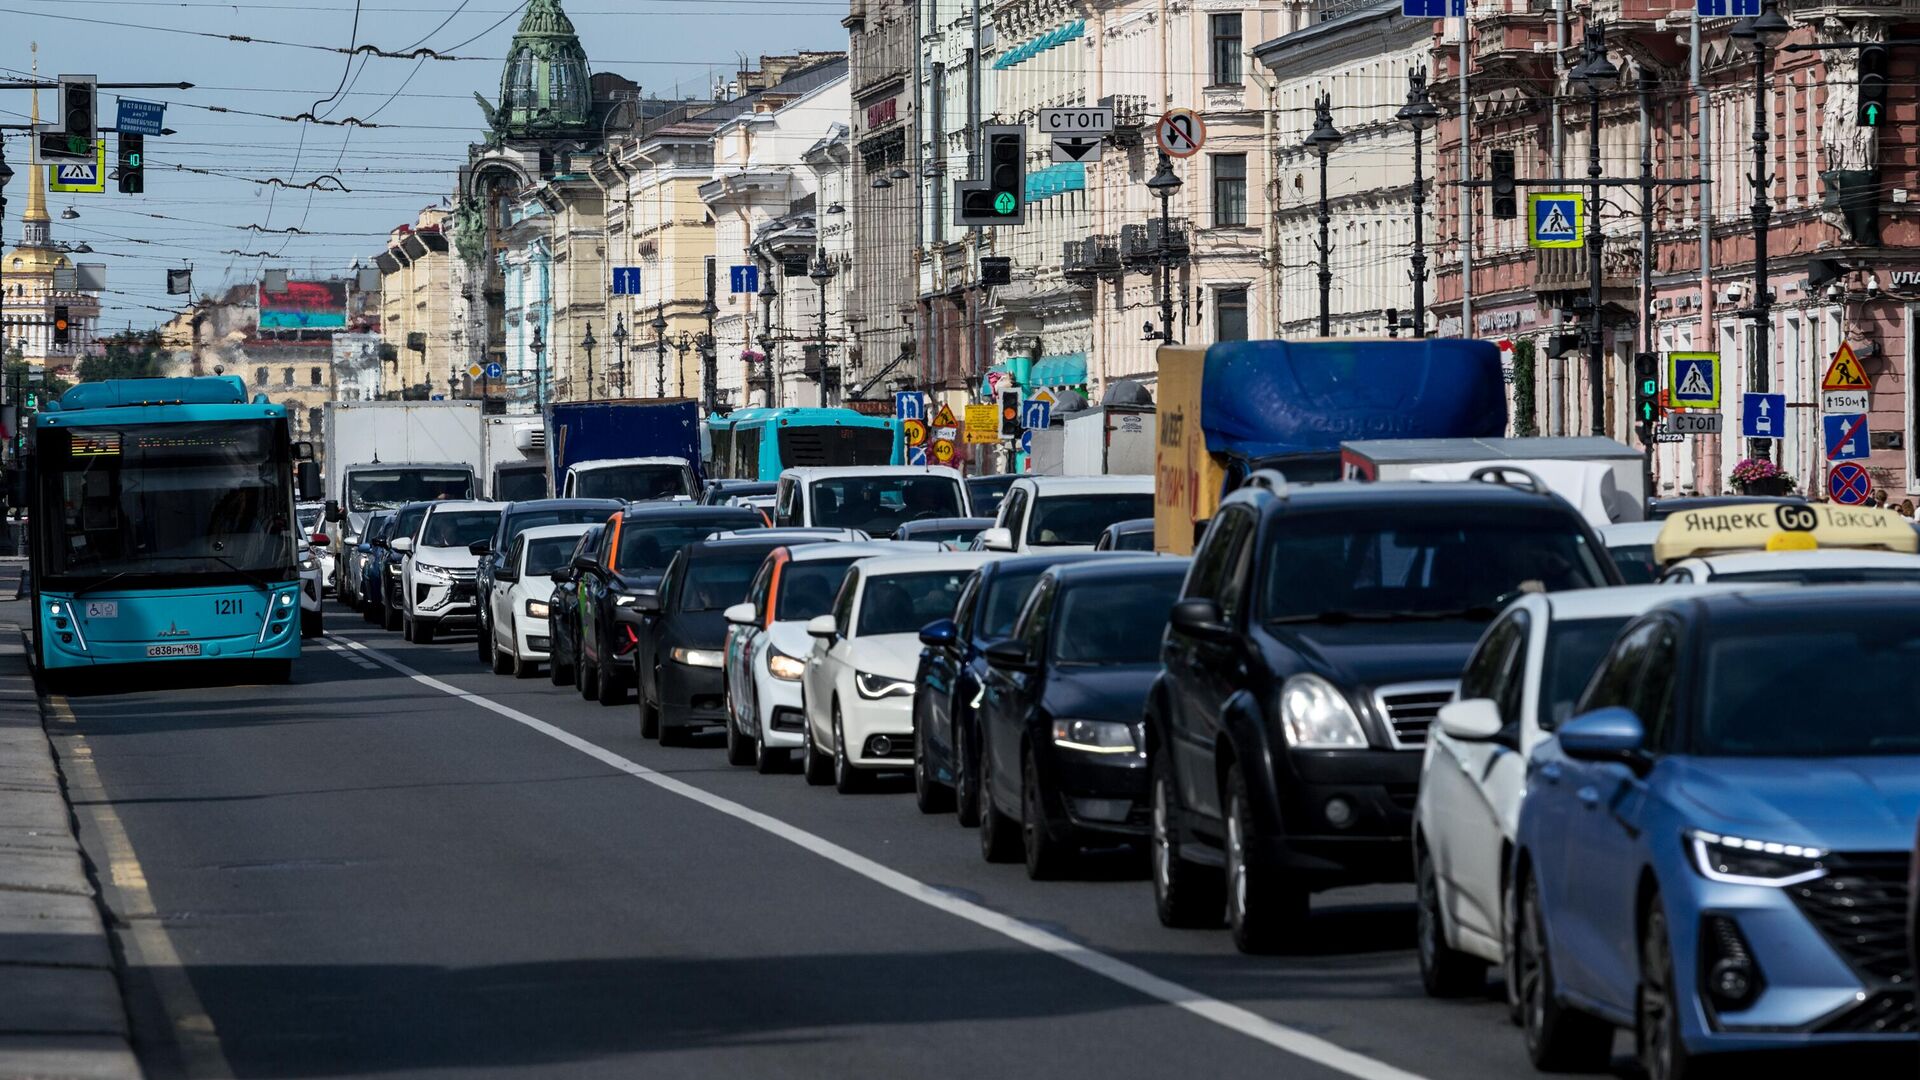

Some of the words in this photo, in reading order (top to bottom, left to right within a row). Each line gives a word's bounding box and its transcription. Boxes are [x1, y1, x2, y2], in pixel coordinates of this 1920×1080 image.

[1050, 113, 1104, 128] СТОП
[130, 153, 140, 167] 10
[1644, 380, 1656, 395] 10
[1676, 416, 1716, 431] СТОП
[1656, 433, 1684, 441] PIZZA
[936, 445, 951, 455] 40
[1685, 511, 1770, 532] Яндекс
[1779, 506, 1816, 529] Go
[1824, 507, 1888, 528] Такси
[214, 598, 243, 615] 1211
